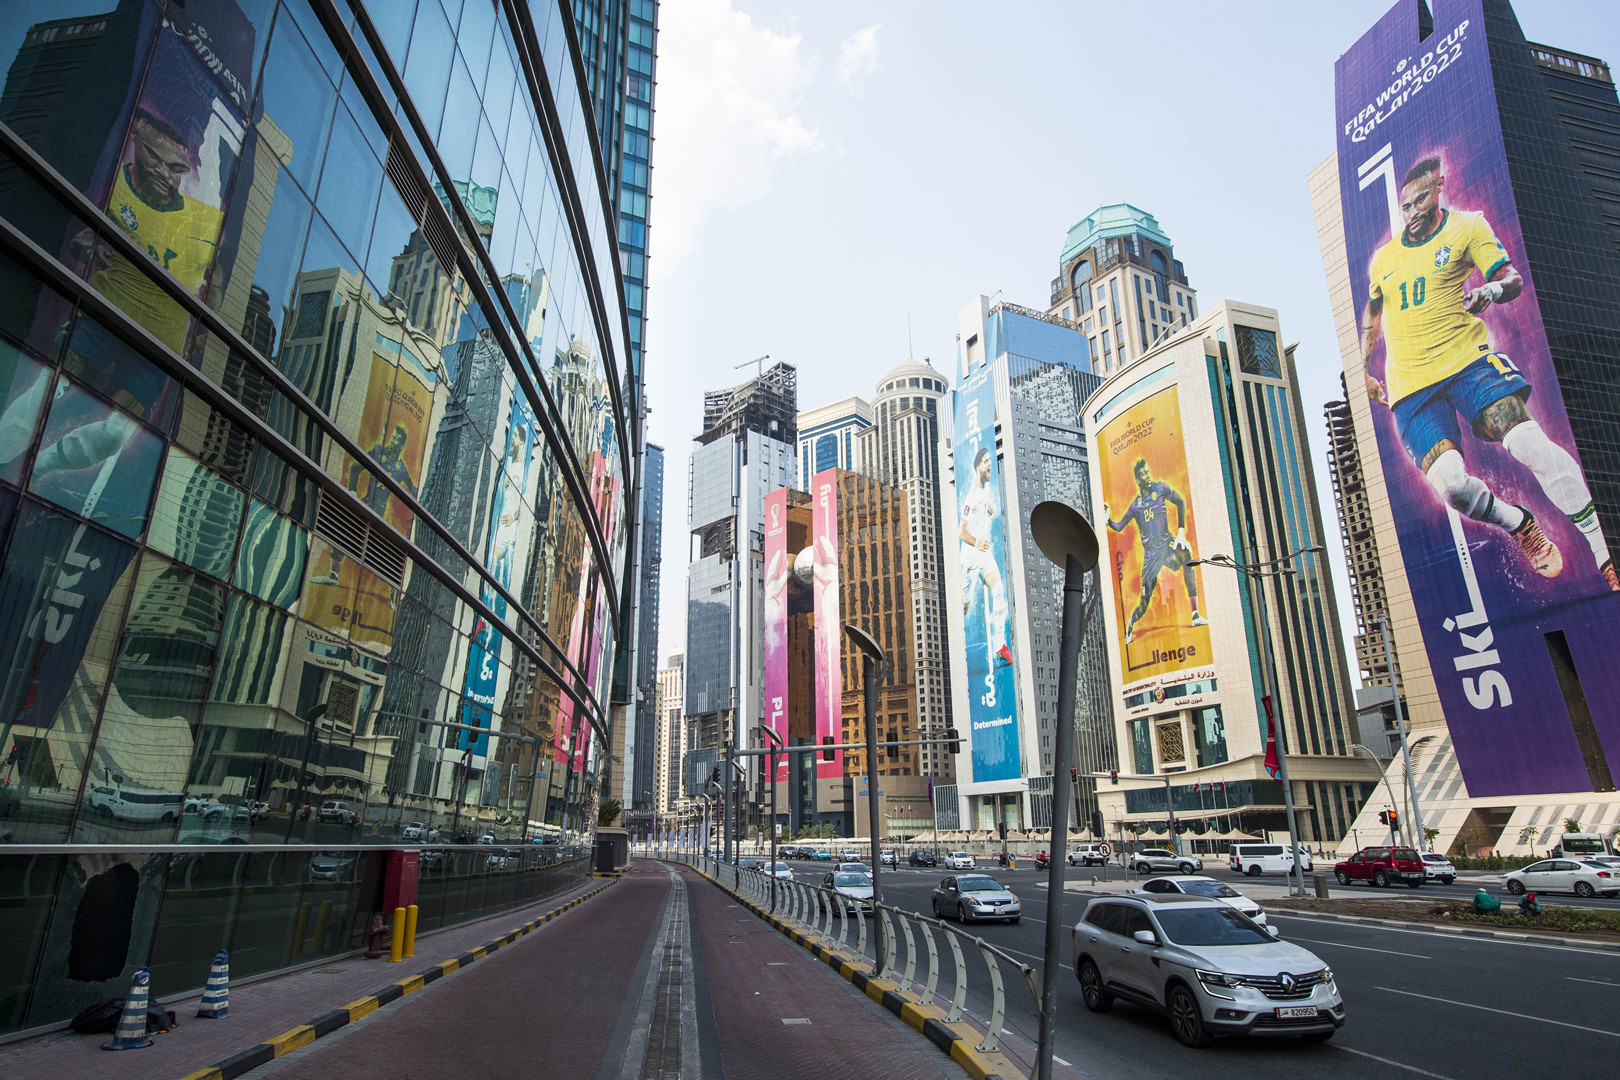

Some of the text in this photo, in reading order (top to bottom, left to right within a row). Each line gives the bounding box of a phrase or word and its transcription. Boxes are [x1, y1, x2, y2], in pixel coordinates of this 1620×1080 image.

[1345, 19, 1469, 136] FIFA WORLD CUP
[1399, 275, 1427, 312] 10
[1121, 424, 1142, 441] WORLD
[1142, 417, 1155, 428] CUP
[1144, 507, 1155, 522] 24
[974, 715, 1013, 730] Determined
[1291, 1008, 1315, 1017] 820950
